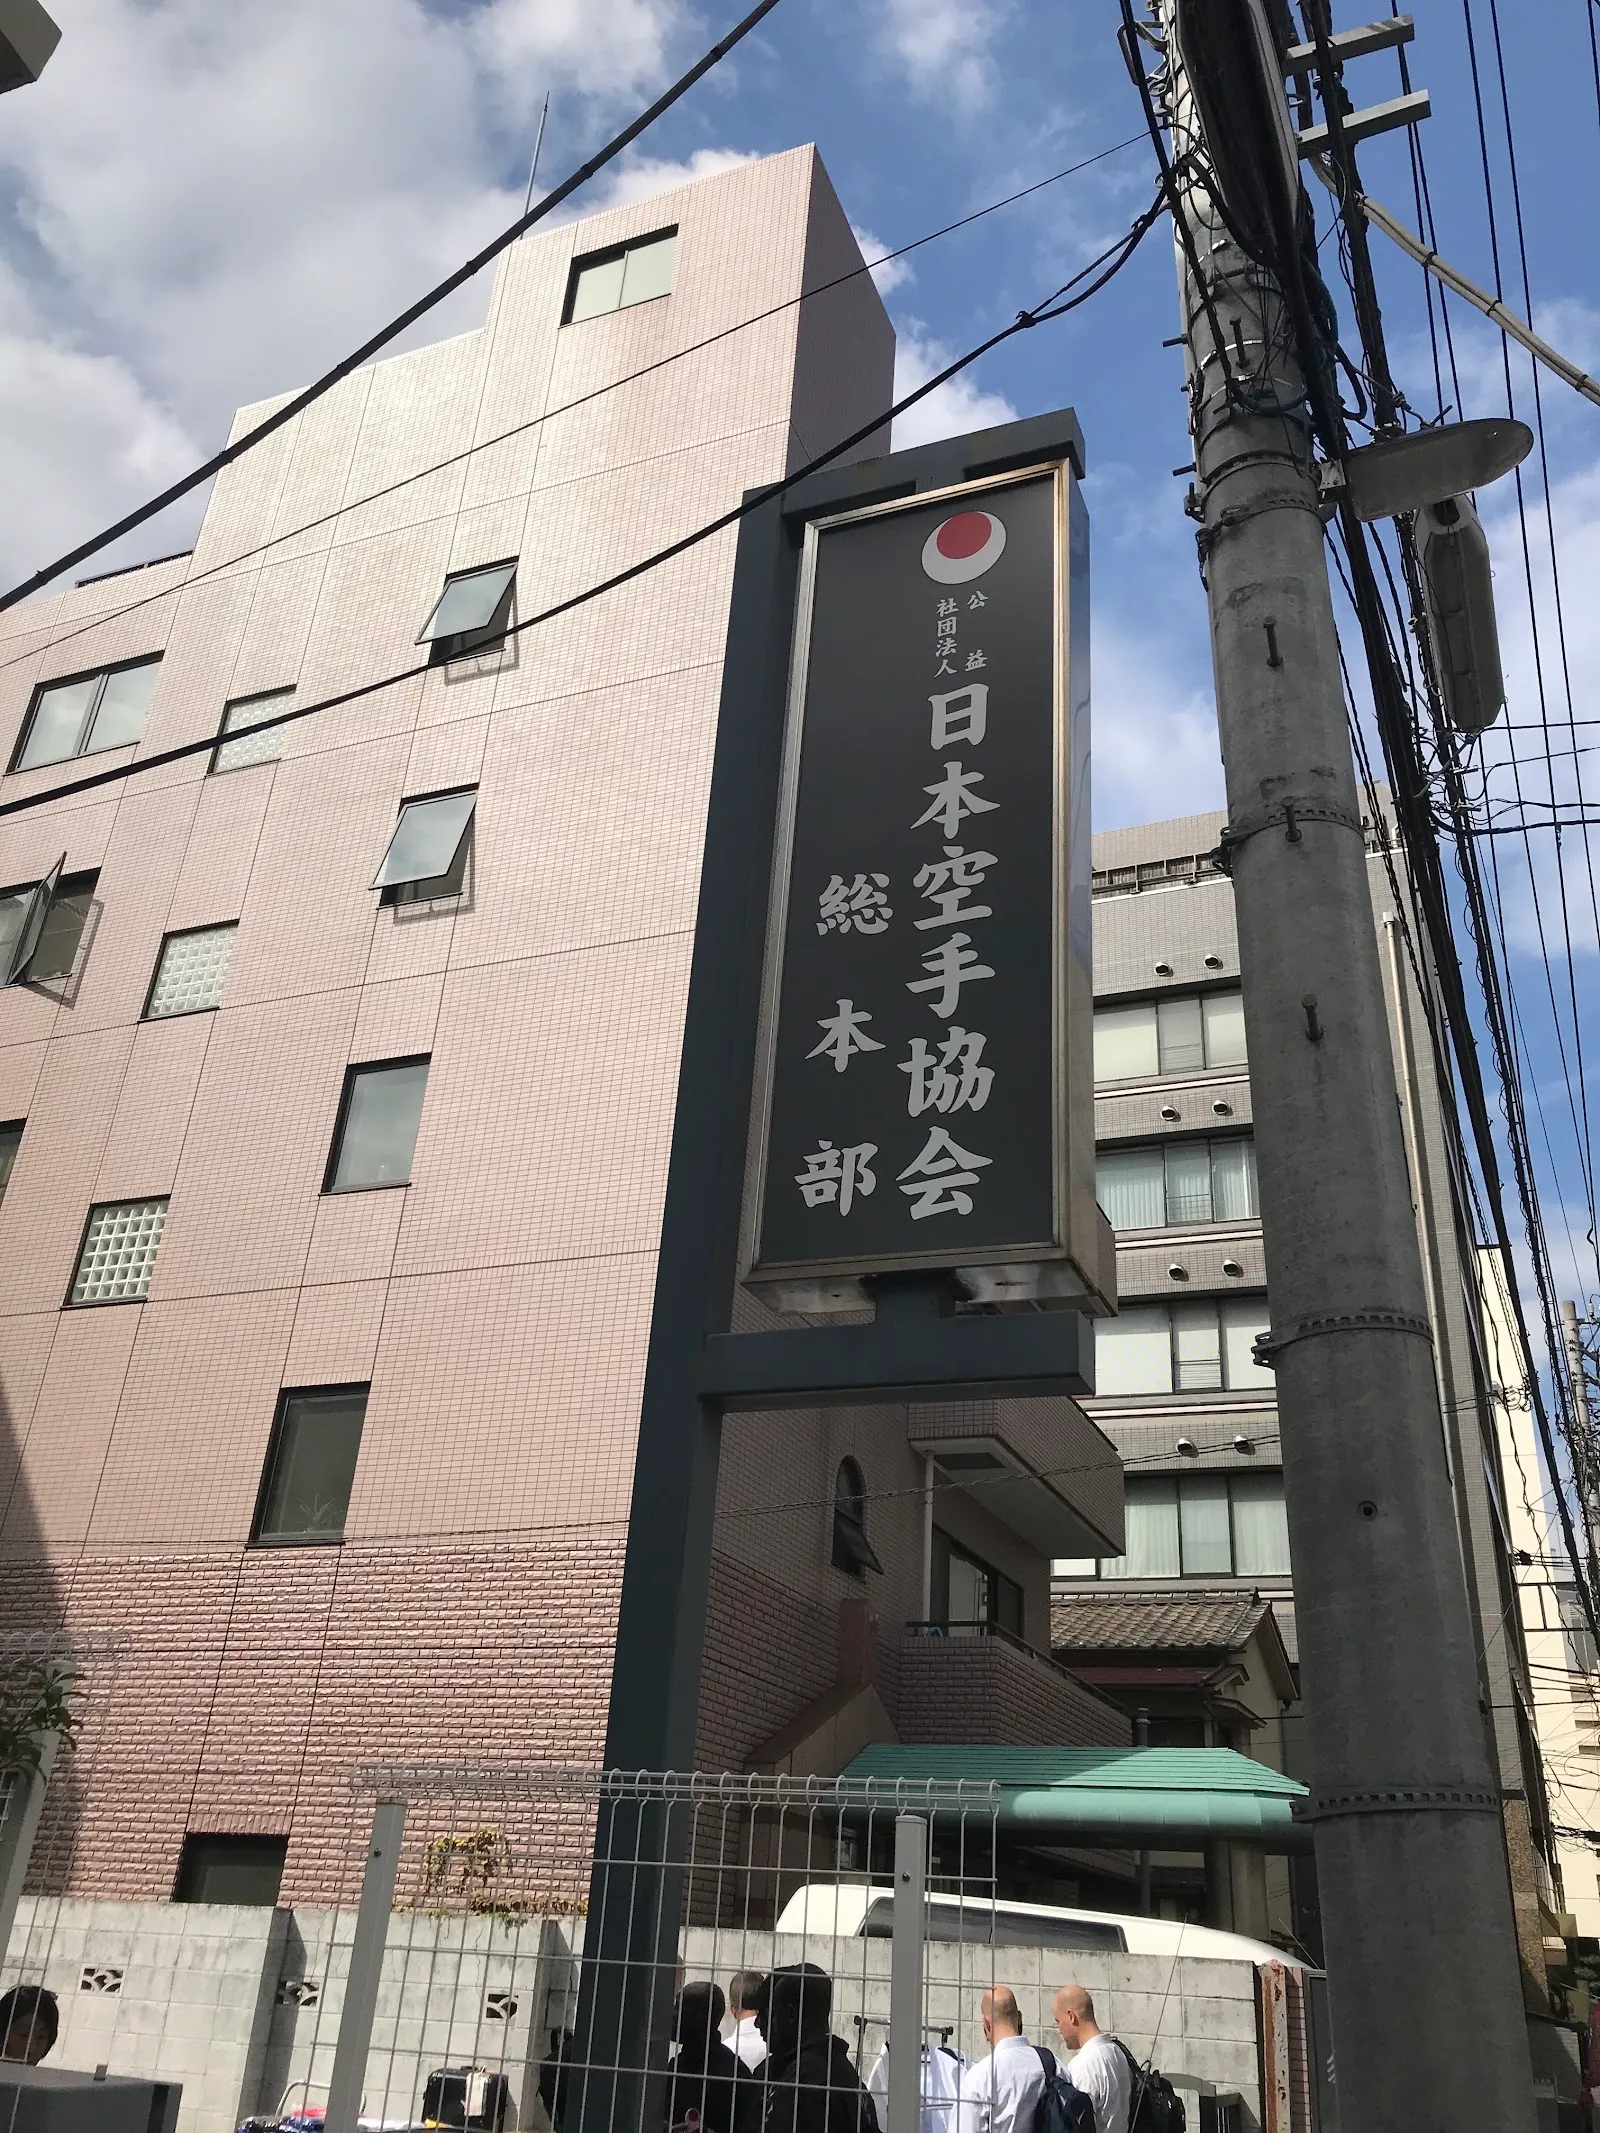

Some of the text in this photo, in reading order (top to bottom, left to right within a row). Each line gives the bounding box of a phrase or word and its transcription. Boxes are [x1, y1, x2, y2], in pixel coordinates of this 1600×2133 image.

[934, 597, 960, 678] 社団法人
[966, 590, 989, 672] 公益
[794, 873, 894, 1216] 総本部
[896, 683, 1000, 1220] 日本空手協会
